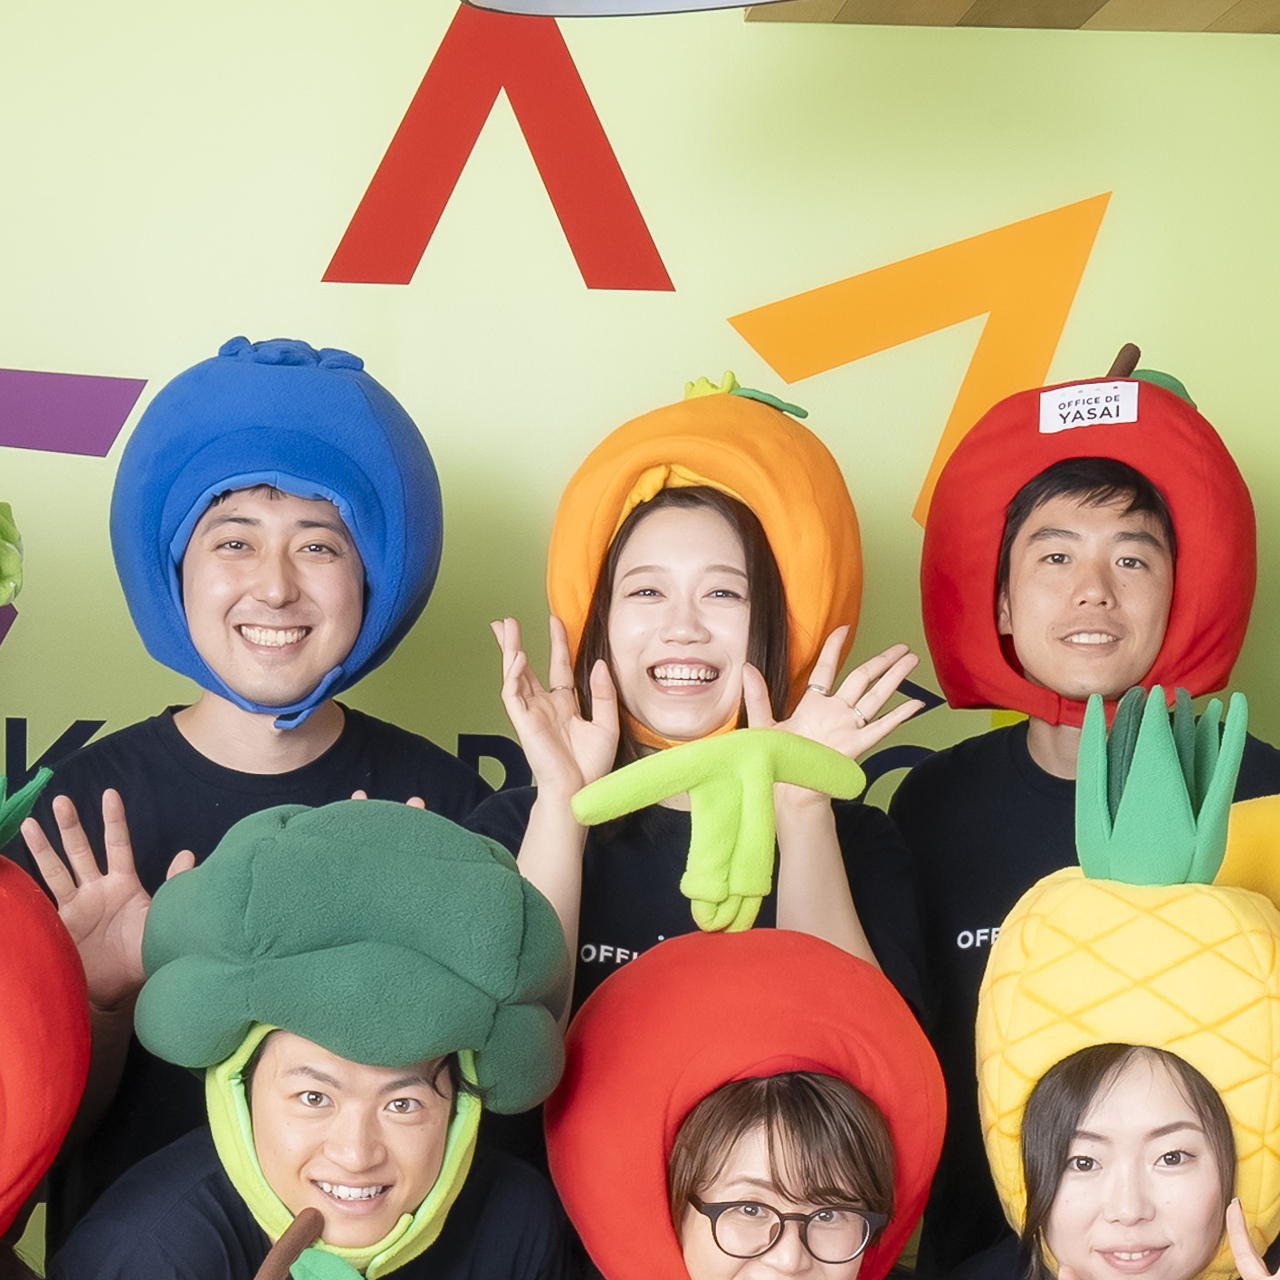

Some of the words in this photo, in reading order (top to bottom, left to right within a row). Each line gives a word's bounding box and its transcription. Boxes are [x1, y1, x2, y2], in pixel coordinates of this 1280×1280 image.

[1058, 397, 1101, 410] OFFICE
[1105, 394, 1120, 403] DE
[1059, 405, 1120, 424] YASAI
[957, 927, 1001, 949] OFF
